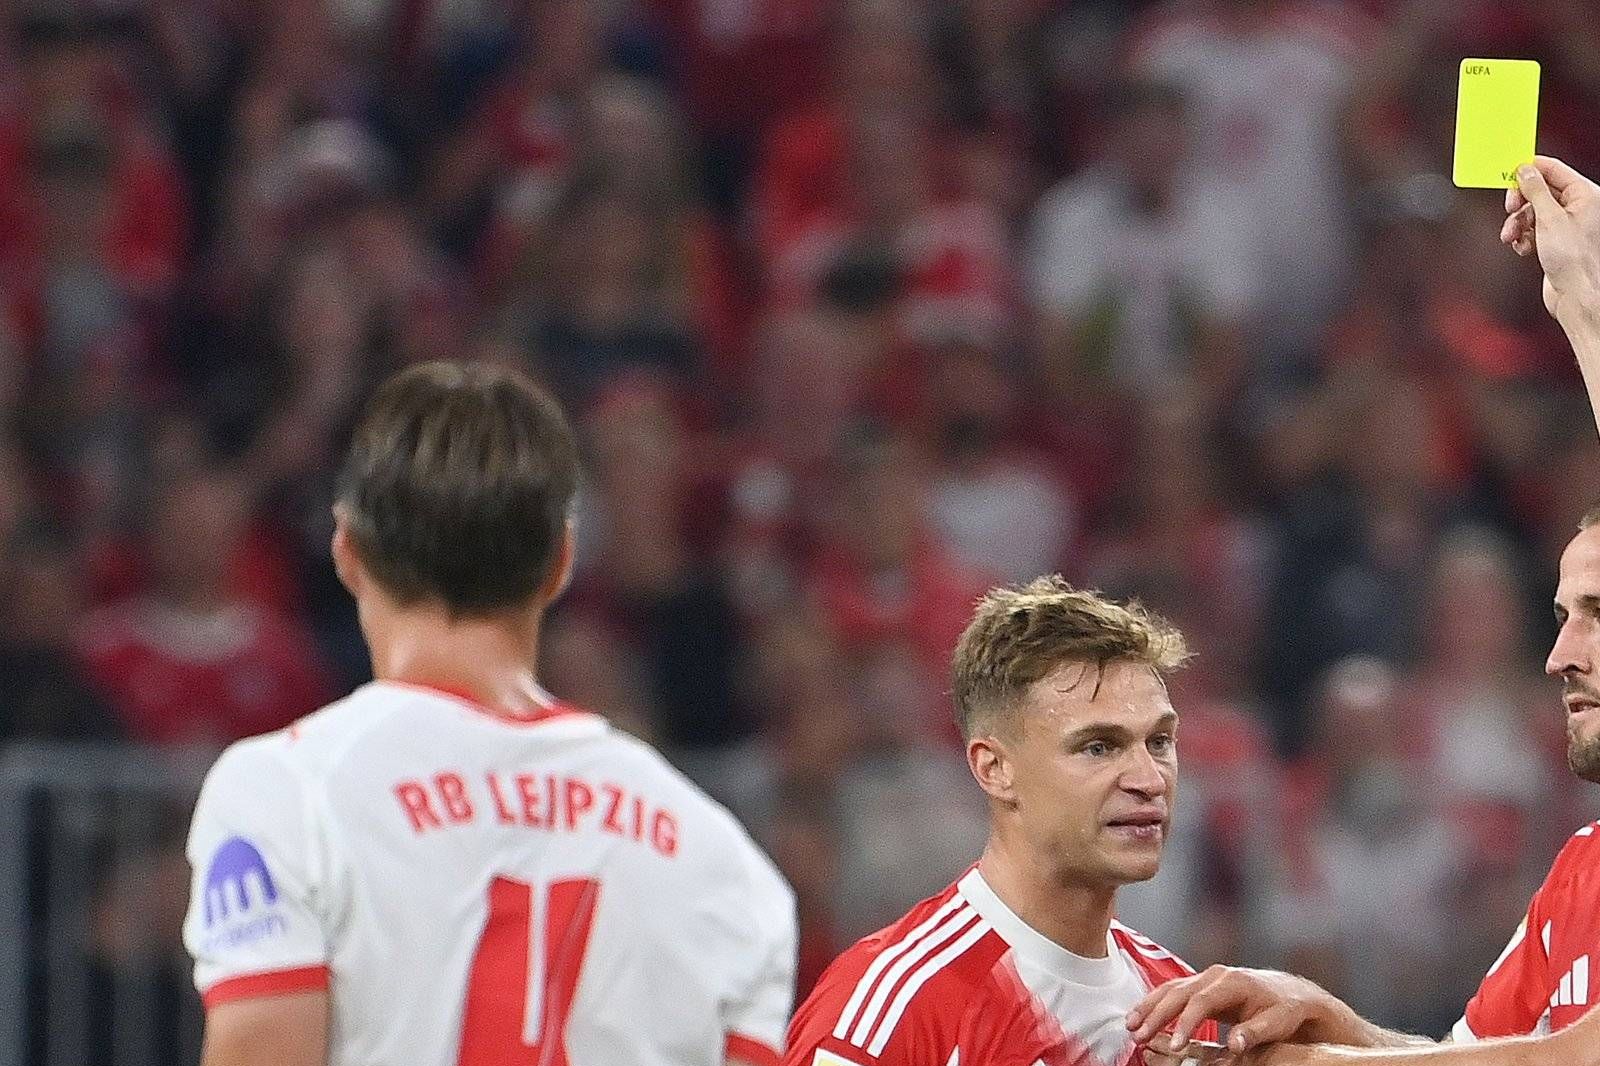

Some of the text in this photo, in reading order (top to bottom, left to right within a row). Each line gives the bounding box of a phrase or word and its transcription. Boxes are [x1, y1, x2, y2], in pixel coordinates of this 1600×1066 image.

[1465, 66, 1491, 76] UEFA
[393, 771, 680, 858] RB LEIPZIG
